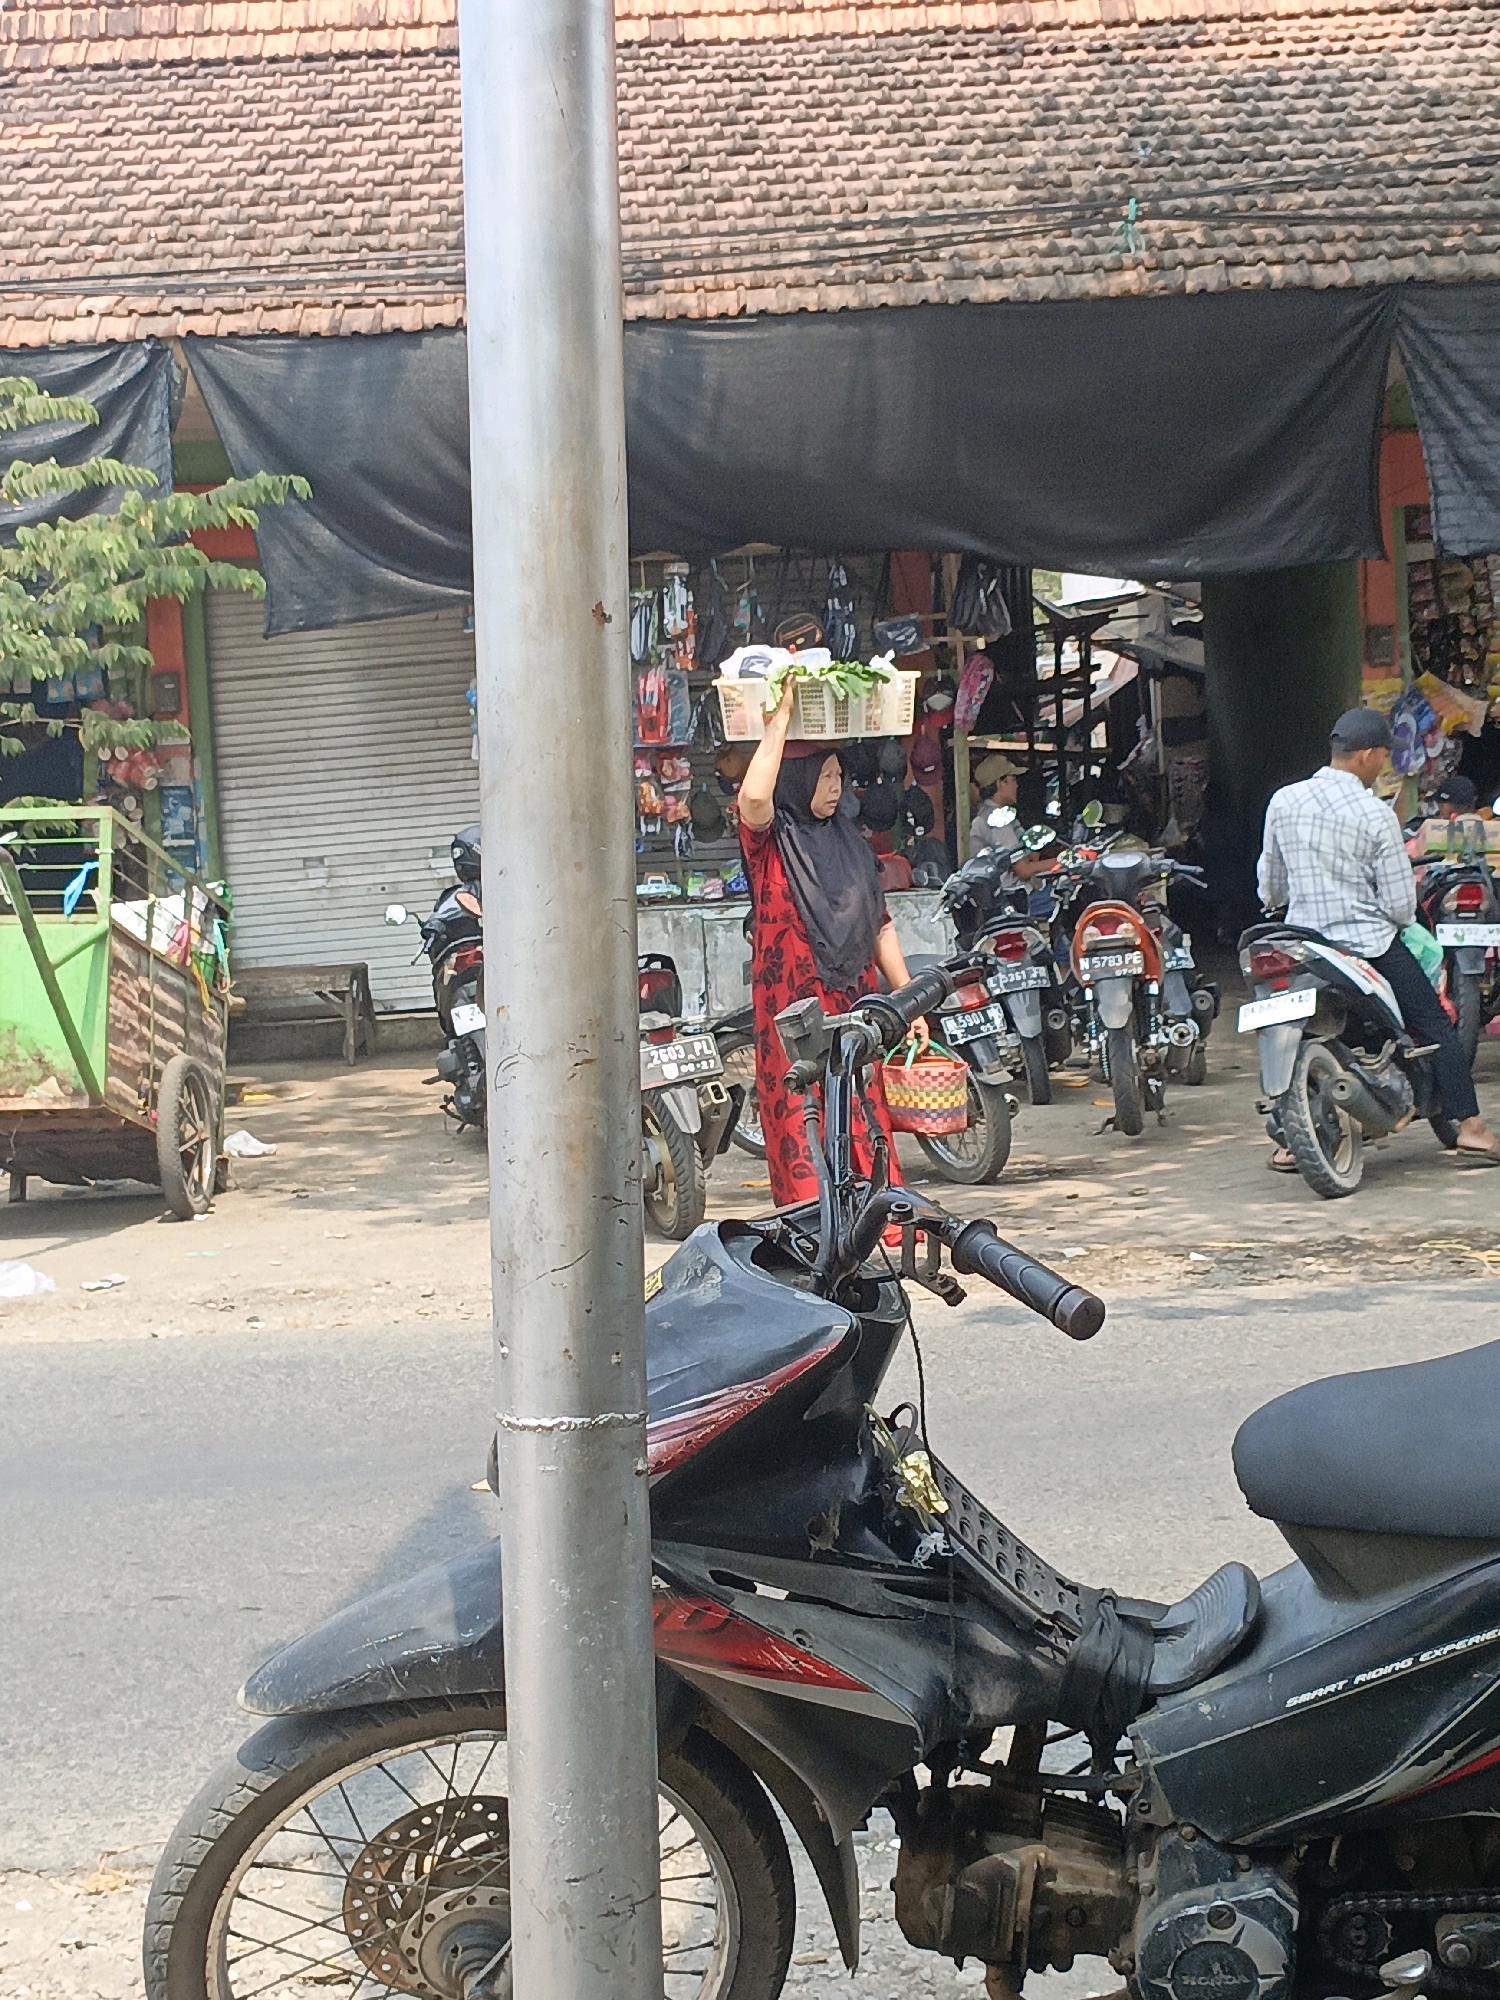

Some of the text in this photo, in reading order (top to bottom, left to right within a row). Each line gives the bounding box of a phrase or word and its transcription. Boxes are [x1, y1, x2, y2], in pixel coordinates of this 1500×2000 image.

[1079, 951, 1142, 971] N 5783 PE
[650, 1040, 712, 1065] 2603 PL
[1285, 1628, 1500, 1708] SMART RIDING EXPERIE
